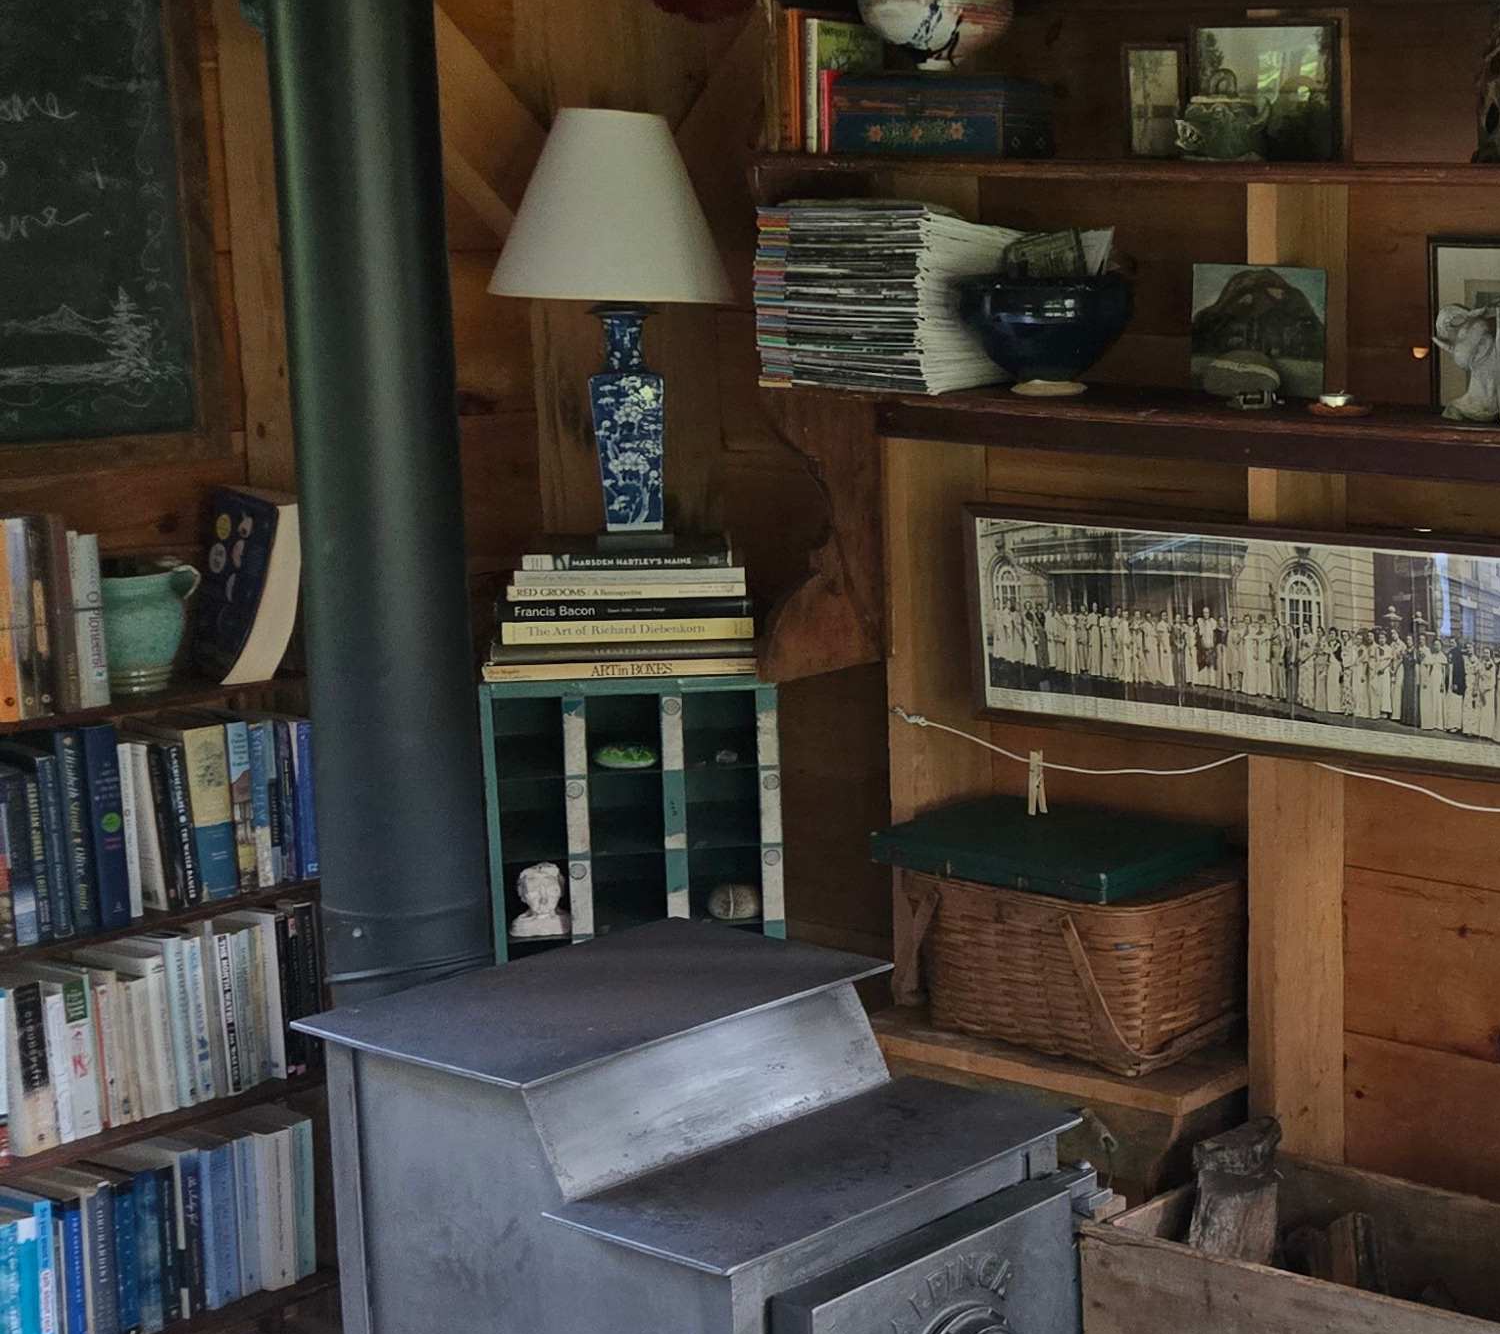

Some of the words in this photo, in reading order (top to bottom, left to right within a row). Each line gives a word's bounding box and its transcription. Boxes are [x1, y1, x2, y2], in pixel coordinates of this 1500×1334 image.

[571, 558, 615, 568] MARSDEN
[616, 557, 663, 567] HARTLEY'S
[664, 557, 693, 566] MAINE
[86, 590, 100, 603] O
[516, 588, 538, 597] RED
[540, 587, 587, 597] GROOMS
[513, 605, 557, 618] Francis
[559, 605, 596, 617] Bacon
[88, 608, 107, 669] Pioneers!
[527, 625, 551, 637] The
[553, 624, 574, 636] Art
[575, 624, 588, 636] of
[590, 623, 638, 635] Richard
[640, 622, 707, 634] Diebenkorn
[591, 664, 617, 677] ART
[617, 664, 629, 675] in
[630, 662, 674, 675] BOXES
[63, 747, 80, 799] Elizabeth
[26, 781, 42, 828] SEBASTIAN
[66, 800, 82, 833] Strout
[180, 827, 190, 844] THE
[183, 844, 194, 868] WATER
[186, 869, 199, 899] DANCER
[219, 939, 231, 959] THE
[220, 959, 233, 990] NORTH
[223, 991, 236, 1024] WATER
[41, 1271, 53, 1289] talk
[42, 1291, 53, 1314] about
